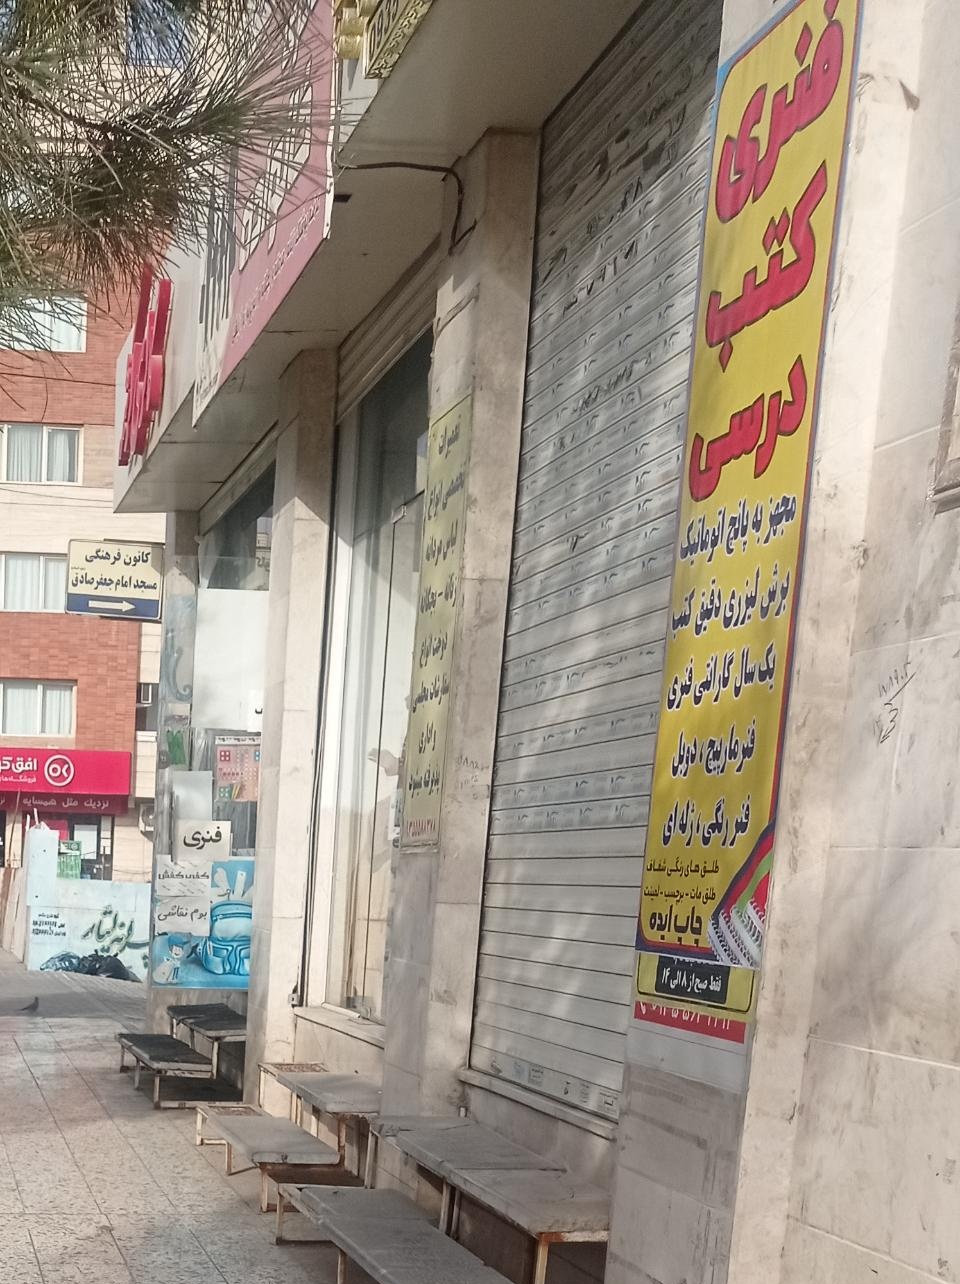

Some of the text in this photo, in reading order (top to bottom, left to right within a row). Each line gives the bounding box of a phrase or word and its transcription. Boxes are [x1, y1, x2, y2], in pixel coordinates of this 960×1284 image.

[715, 0, 844, 224] فنری
[705, 160, 828, 373] کتب
[689, 355, 808, 501] درسی
[680, 495, 797, 566] مجهز به پانچ اتوماتیک
[85, 548, 151, 566] کانون فرهنگی
[71, 572, 158, 593] مسجد امام جعفر صادق
[672, 562, 790, 639] برش لیزری دقیق کتب
[667, 641, 776, 710] یک سال گارانتی فنری
[12, 757, 38, 773] افق
[672, 730, 697, 777] دوبل
[736, 719, 756, 772] فنر
[22, 796, 110, 810] نزدیک مثل همسایه
[662, 800, 679, 846] ای
[678, 799, 695, 848] ژله
[729, 794, 751, 848] فنر
[183, 826, 222, 850] فنری
[157, 904, 188, 921] نقاشی
[649, 904, 703, 947] چاپ ایده
[709, 975, 722, 992] فقط
